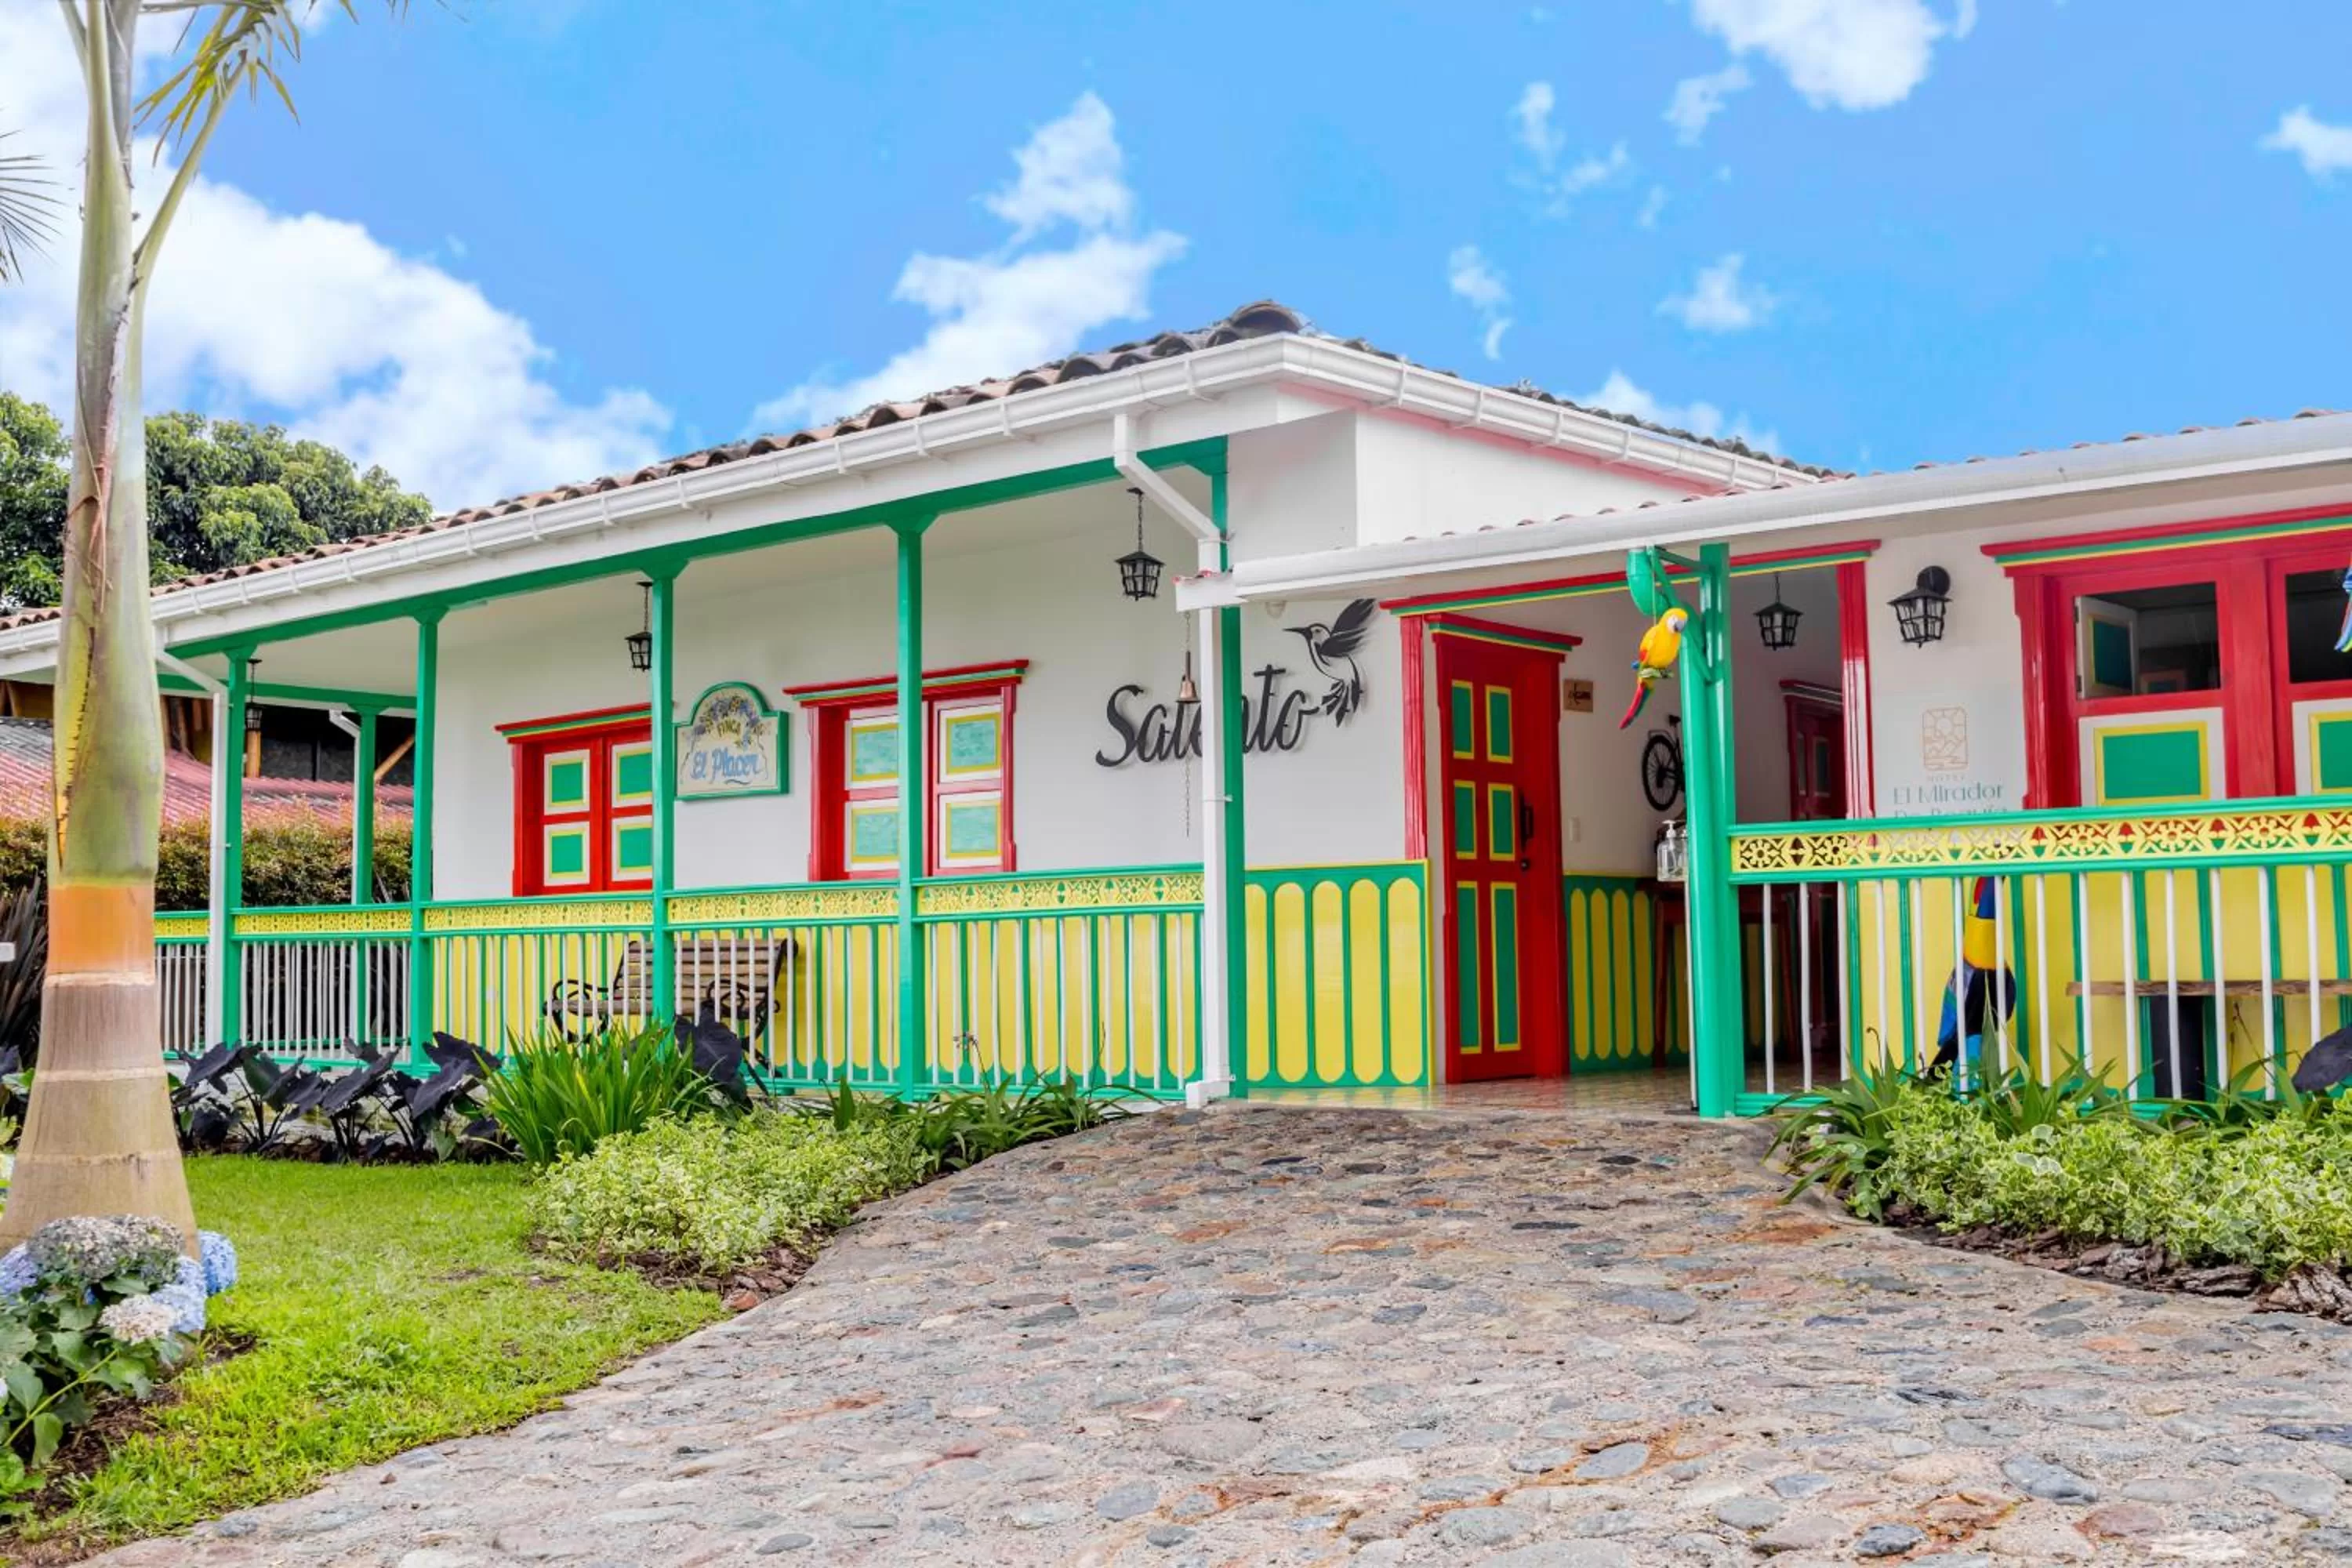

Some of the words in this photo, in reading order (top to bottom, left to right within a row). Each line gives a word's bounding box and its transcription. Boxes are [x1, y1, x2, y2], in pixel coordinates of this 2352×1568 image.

[710, 746, 763, 784] Placer
[1893, 786, 1911, 804] El
[1918, 782, 2004, 804] Mirador
